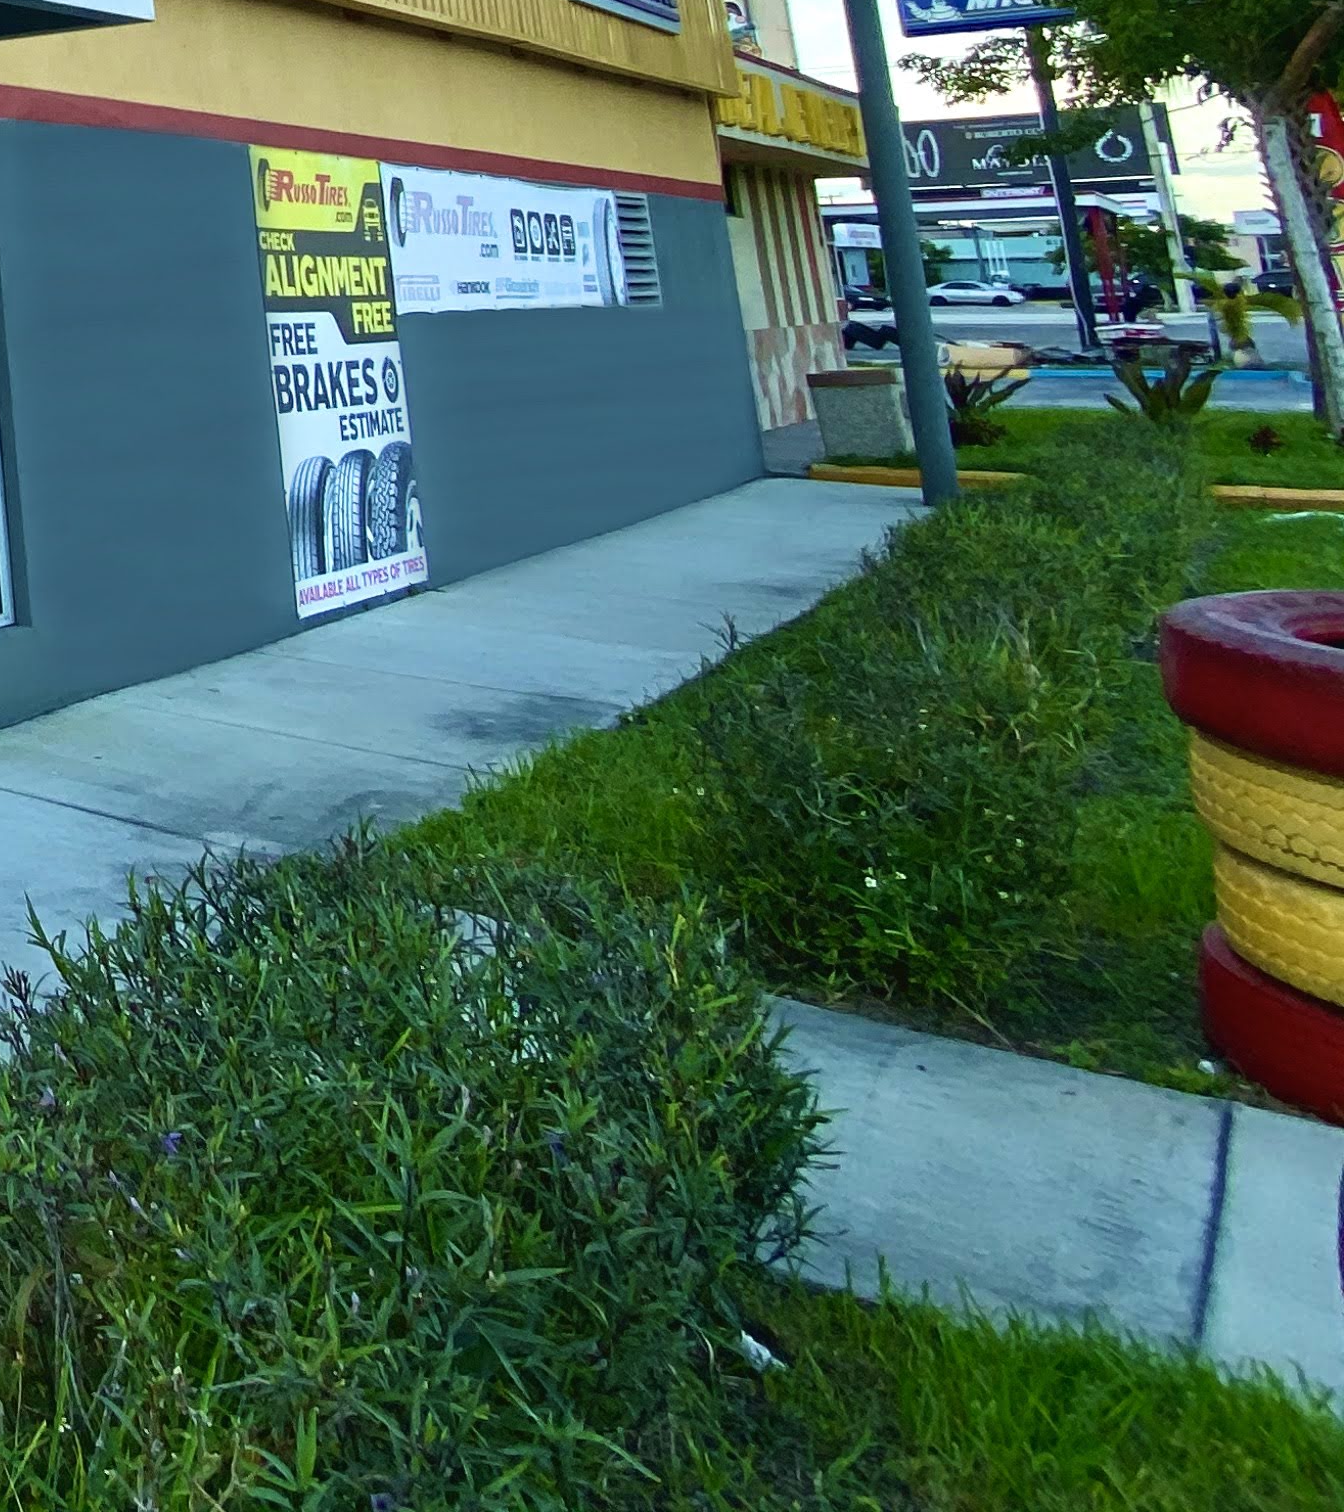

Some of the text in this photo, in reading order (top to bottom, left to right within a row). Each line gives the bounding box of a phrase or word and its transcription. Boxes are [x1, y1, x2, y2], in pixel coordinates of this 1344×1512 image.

[259, 231, 295, 252] CHECK
[266, 254, 387, 298] ALIGNMENT
[351, 301, 395, 335] FREE
[269, 322, 318, 356] FREE
[273, 358, 378, 414] BRAKES
[339, 407, 404, 441] ESTIMATE
[298, 556, 424, 607] AVAILABLE ALL TYPES OF TIRES
